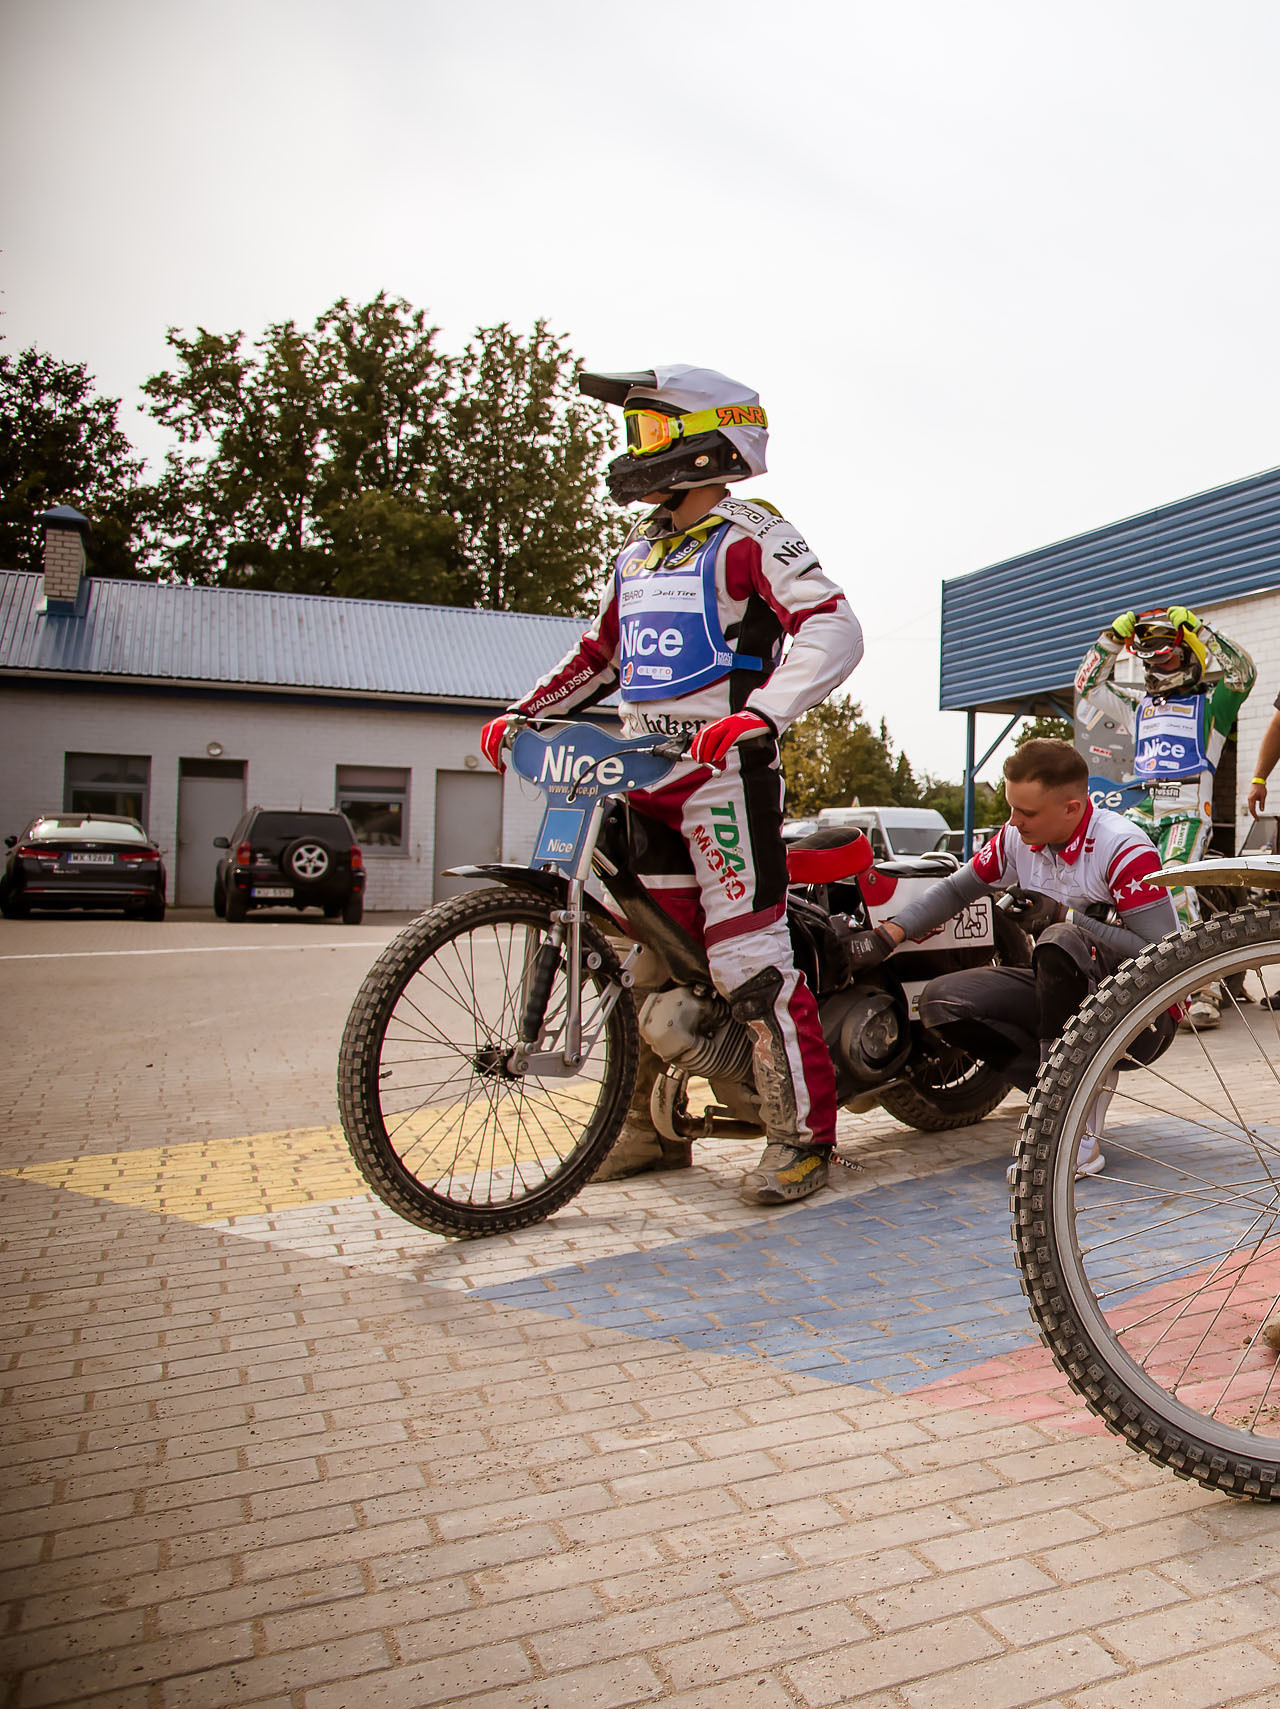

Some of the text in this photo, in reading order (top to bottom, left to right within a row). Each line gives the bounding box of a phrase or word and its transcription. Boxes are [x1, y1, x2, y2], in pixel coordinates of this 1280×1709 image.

[669, 540, 699, 563] Nice
[772, 539, 810, 566] Nic
[620, 620, 684, 661] Nice
[1144, 738, 1185, 758] Nice
[540, 745, 624, 786] Nice
[549, 784, 598, 796] www.ice.pl
[547, 839, 573, 853] Nice
[710, 801, 746, 875] TDA
